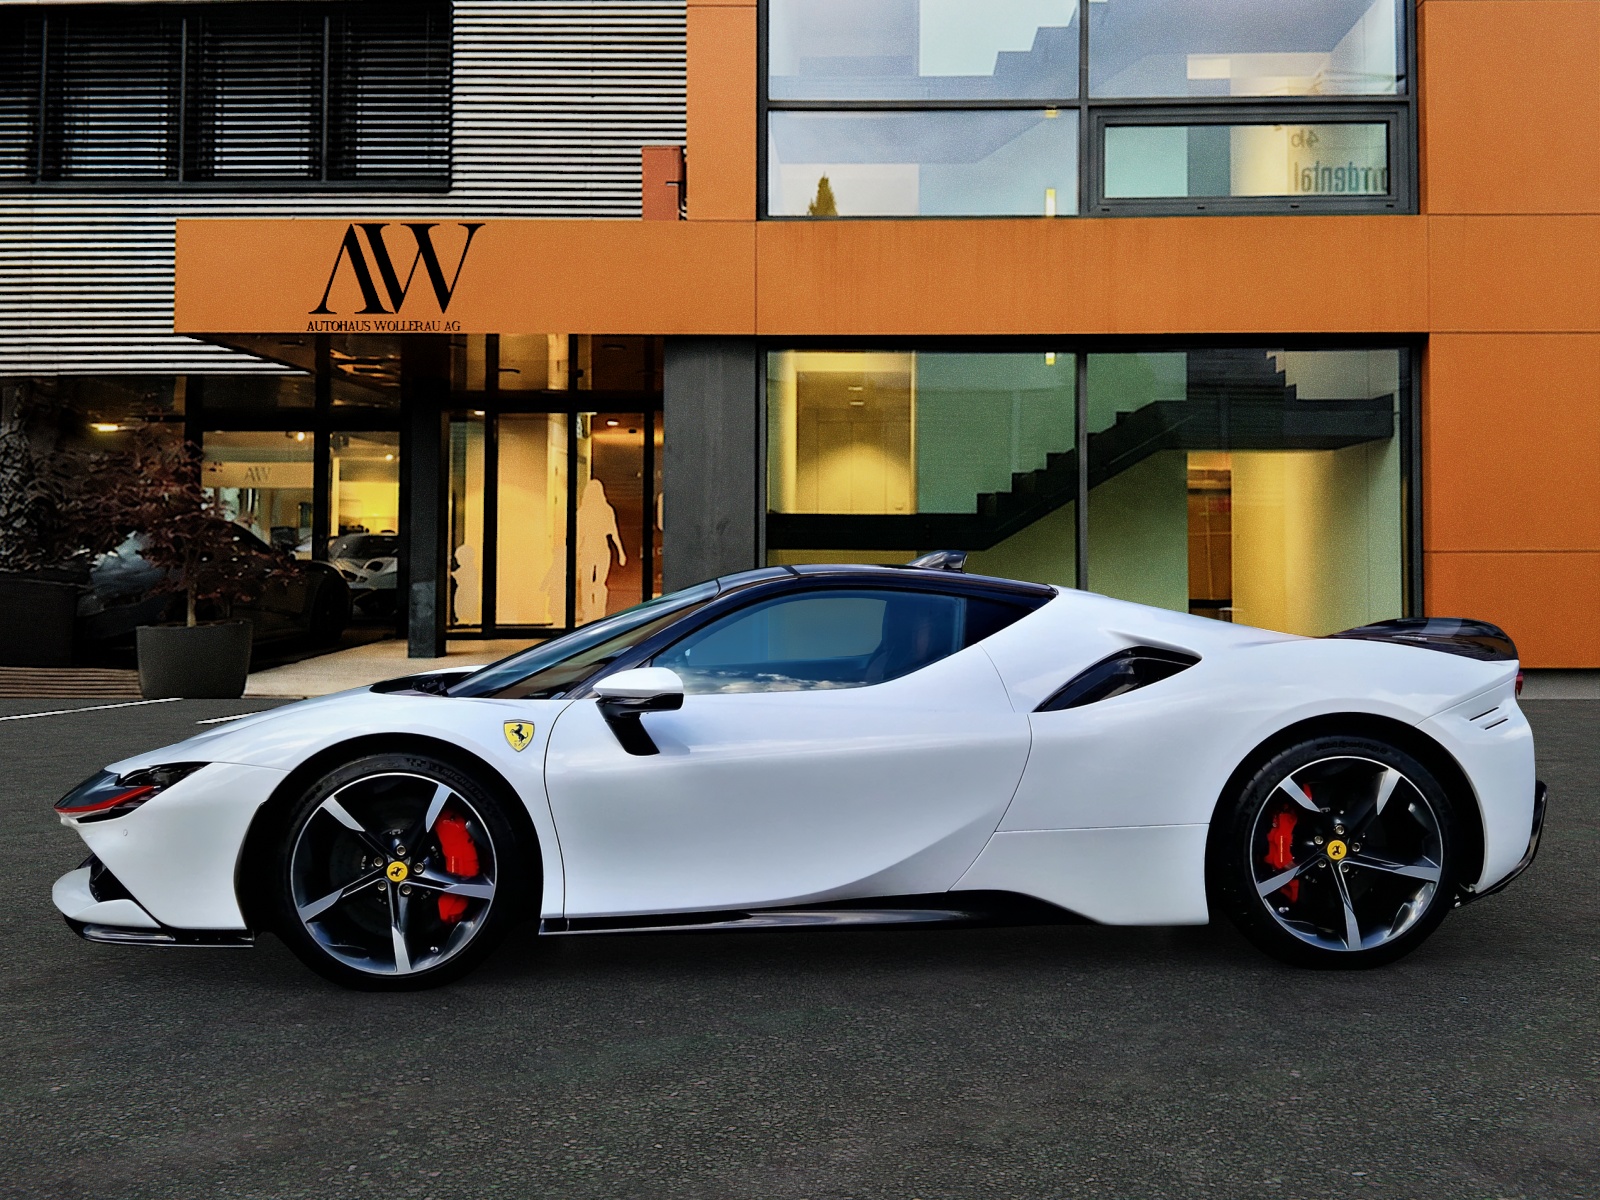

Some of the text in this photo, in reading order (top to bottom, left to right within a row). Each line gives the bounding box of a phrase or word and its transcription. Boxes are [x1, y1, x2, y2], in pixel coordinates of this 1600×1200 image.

[308, 223, 486, 314] AW
[306, 320, 461, 332] AUTOHAUS WOLLERAU AG
